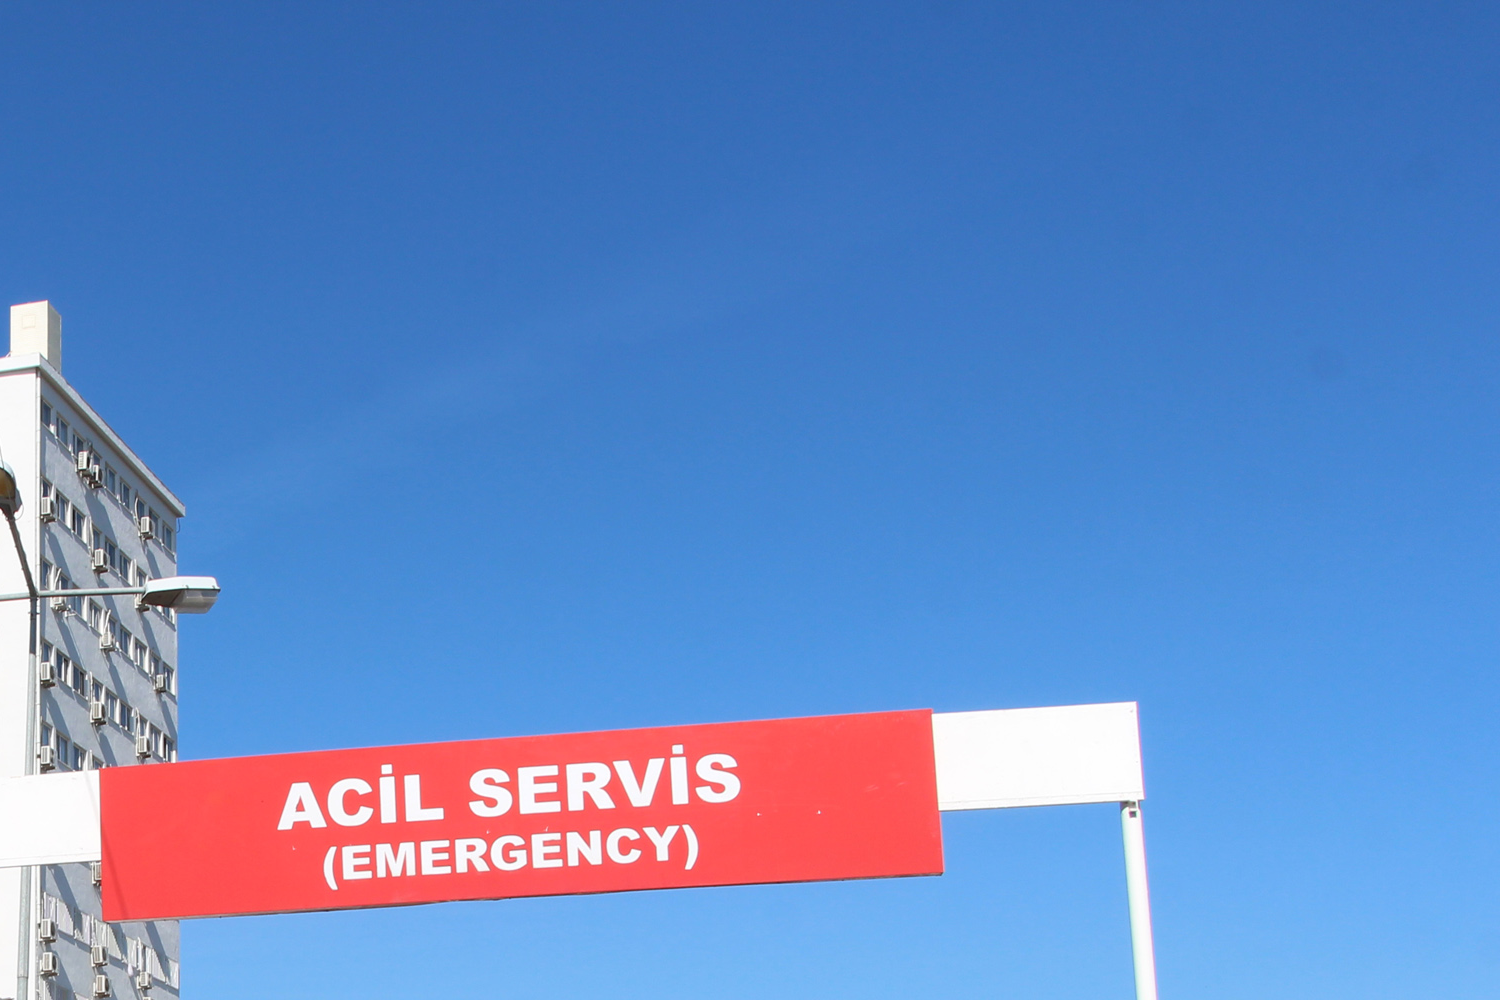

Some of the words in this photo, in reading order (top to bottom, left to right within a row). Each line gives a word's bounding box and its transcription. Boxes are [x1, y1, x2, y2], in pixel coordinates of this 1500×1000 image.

[277, 763, 444, 830] ACİL
[468, 744, 741, 817] SERVİS
[322, 824, 700, 890] (EMERGENCY)
